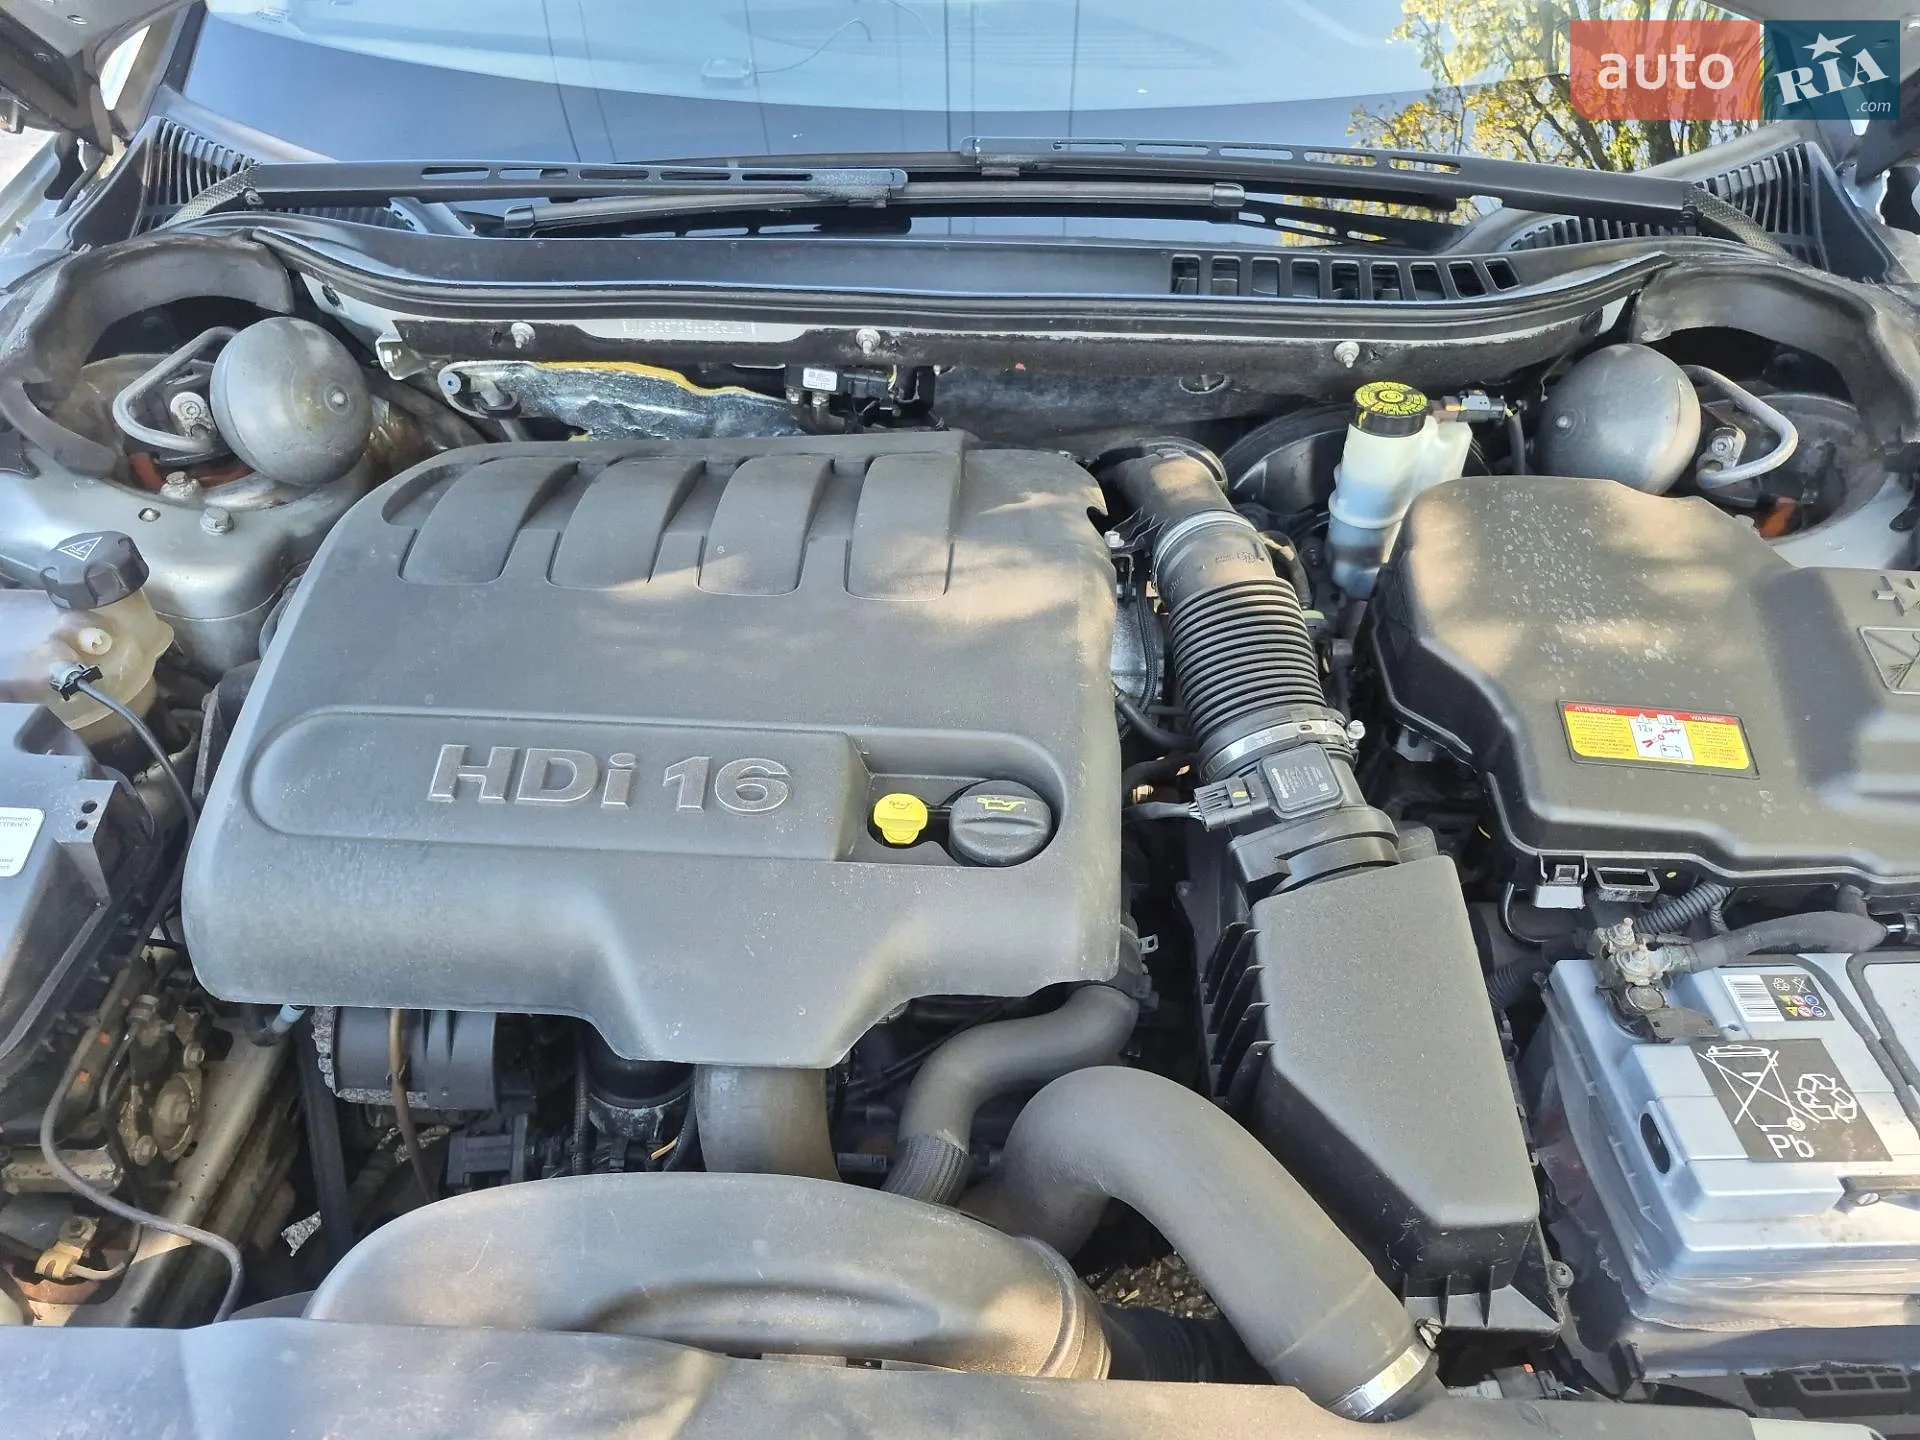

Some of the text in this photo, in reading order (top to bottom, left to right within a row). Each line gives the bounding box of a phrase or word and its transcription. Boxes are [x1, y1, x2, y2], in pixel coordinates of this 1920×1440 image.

[427, 743, 792, 815] HDi 16
[1766, 1134, 1815, 1159] Pb
